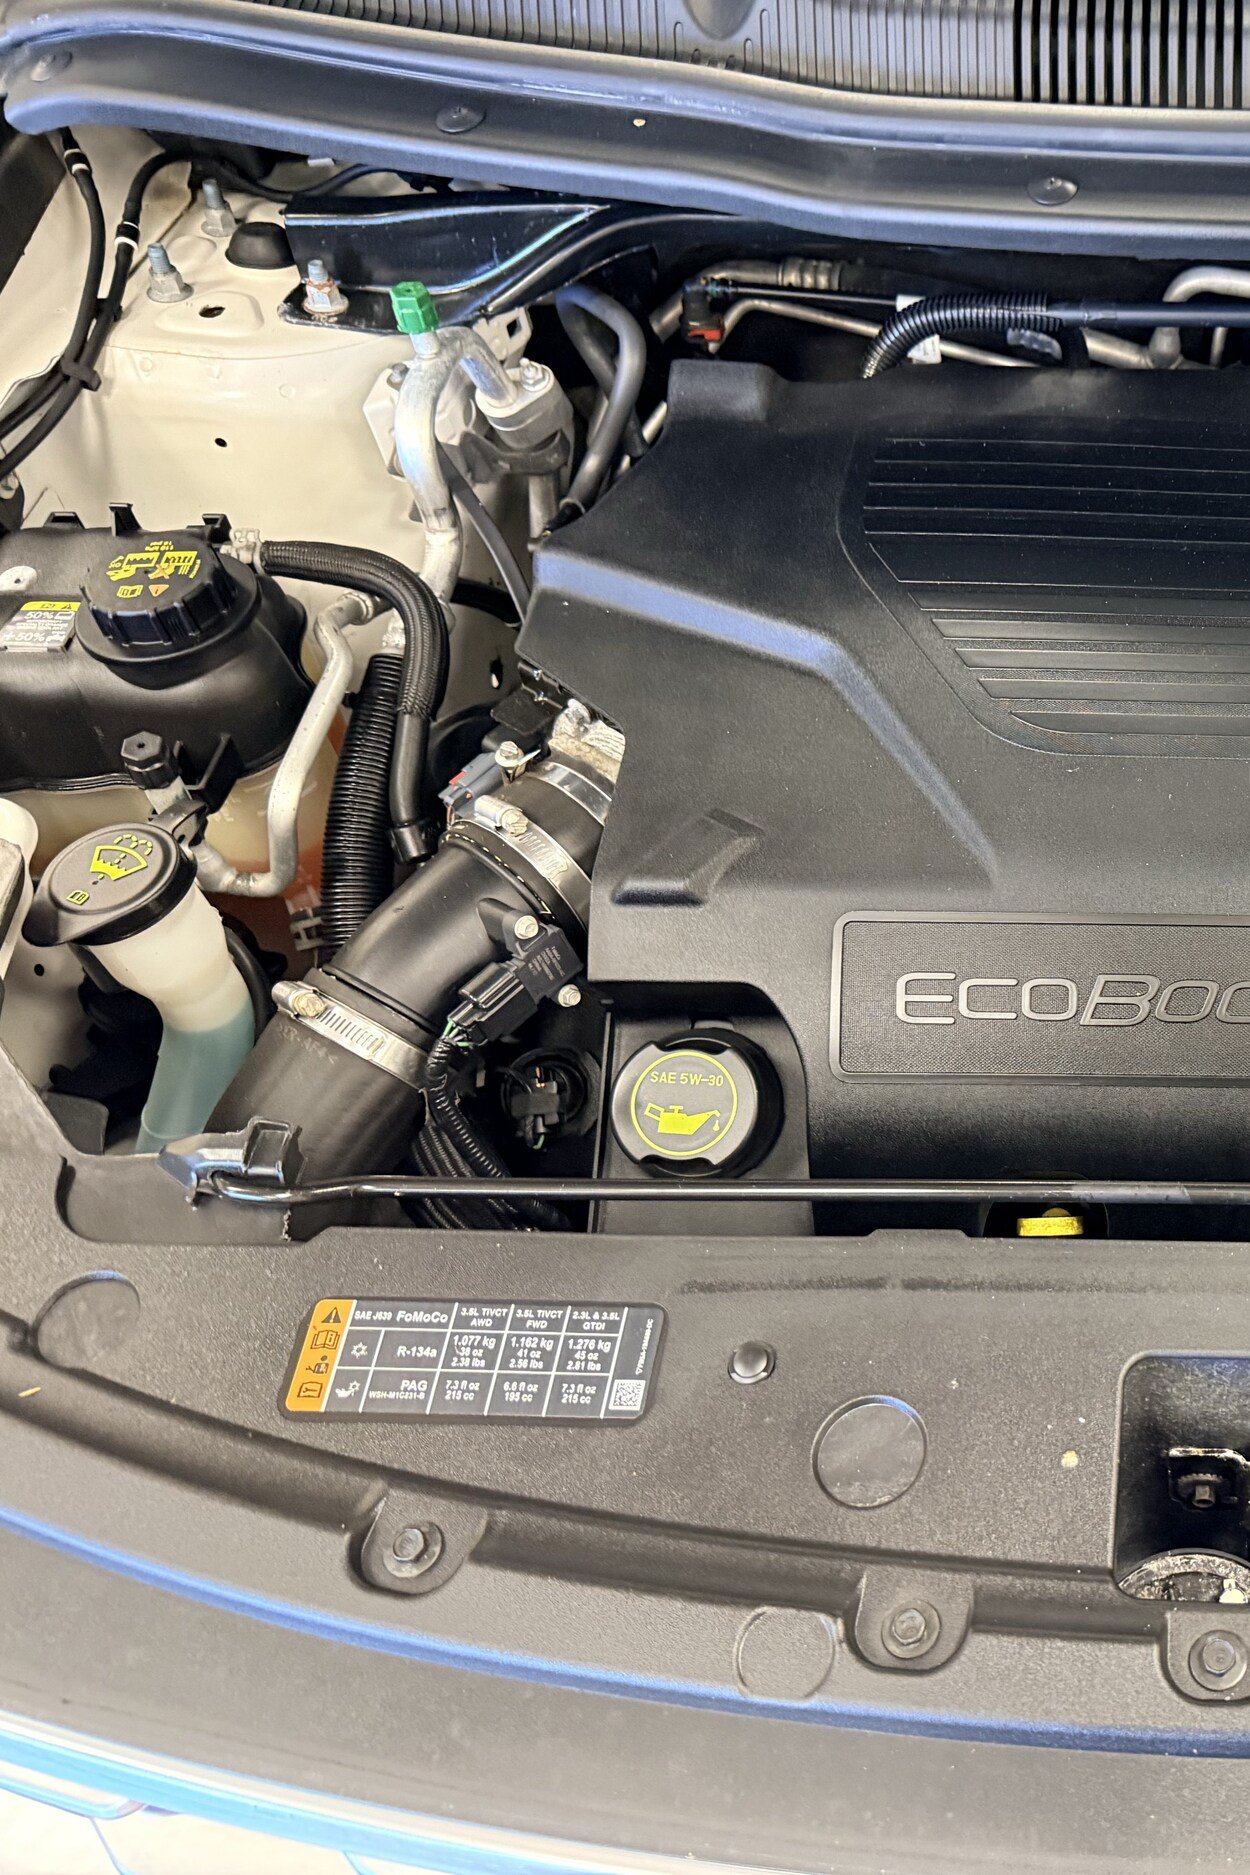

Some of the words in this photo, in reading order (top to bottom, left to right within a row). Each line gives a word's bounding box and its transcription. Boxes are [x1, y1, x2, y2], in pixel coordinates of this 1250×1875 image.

[26, 609, 55, 620] 50%
[650, 1071, 676, 1084] SAE
[680, 1073, 724, 1086] 5W-30
[354, 1311, 371, 1320] SAE
[372, 1312, 392, 1320] J639
[397, 1311, 448, 1323] FoMoCo
[461, 1308, 480, 1316] 3.5L
[482, 1308, 508, 1317] TIVCT
[516, 1310, 535, 1318] 3.5L
[537, 1310, 563, 1319] TIVCT
[573, 1311, 591, 1319] 2.3L
[470, 1319, 493, 1327] AWD
[454, 1336, 481, 1346] 1.077
[483, 1337, 496, 1348] kg
[511, 1337, 538, 1347] 1.162
[540, 1338, 554, 1350] kg
[568, 1339, 596, 1349] 1.276
[598, 1340, 611, 1352] kg
[397, 1346, 437, 1358] R-134a
[460, 1348, 470, 1356] 38
[472, 1349, 483, 1357] oz
[517, 1349, 528, 1357] 41
[530, 1350, 541, 1358] oz
[587, 1352, 598, 1360] oz
[451, 1357, 470, 1366] 2.38
[471, 1358, 485, 1367] lbs
[509, 1358, 528, 1368] 2.56
[530, 1359, 543, 1369] lbs
[567, 1361, 586, 1370] 2.81
[587, 1362, 601, 1371] lbs
[401, 1380, 428, 1391] PAG
[446, 1380, 459, 1389] 7.3
[461, 1381, 467, 1389] fl
[469, 1382, 480, 1390] oz
[504, 1382, 517, 1391] 6.6
[519, 1382, 525, 1391] fl
[527, 1384, 538, 1392] oz
[562, 1384, 575, 1393] 7.3
[577, 1384, 583, 1393] fl
[585, 1385, 596, 1394] oz
[445, 1390, 462, 1399] 215
[463, 1392, 474, 1400] cc
[505, 1392, 521, 1401] 195
[522, 1394, 533, 1402] cc
[562, 1394, 578, 1403] 215
